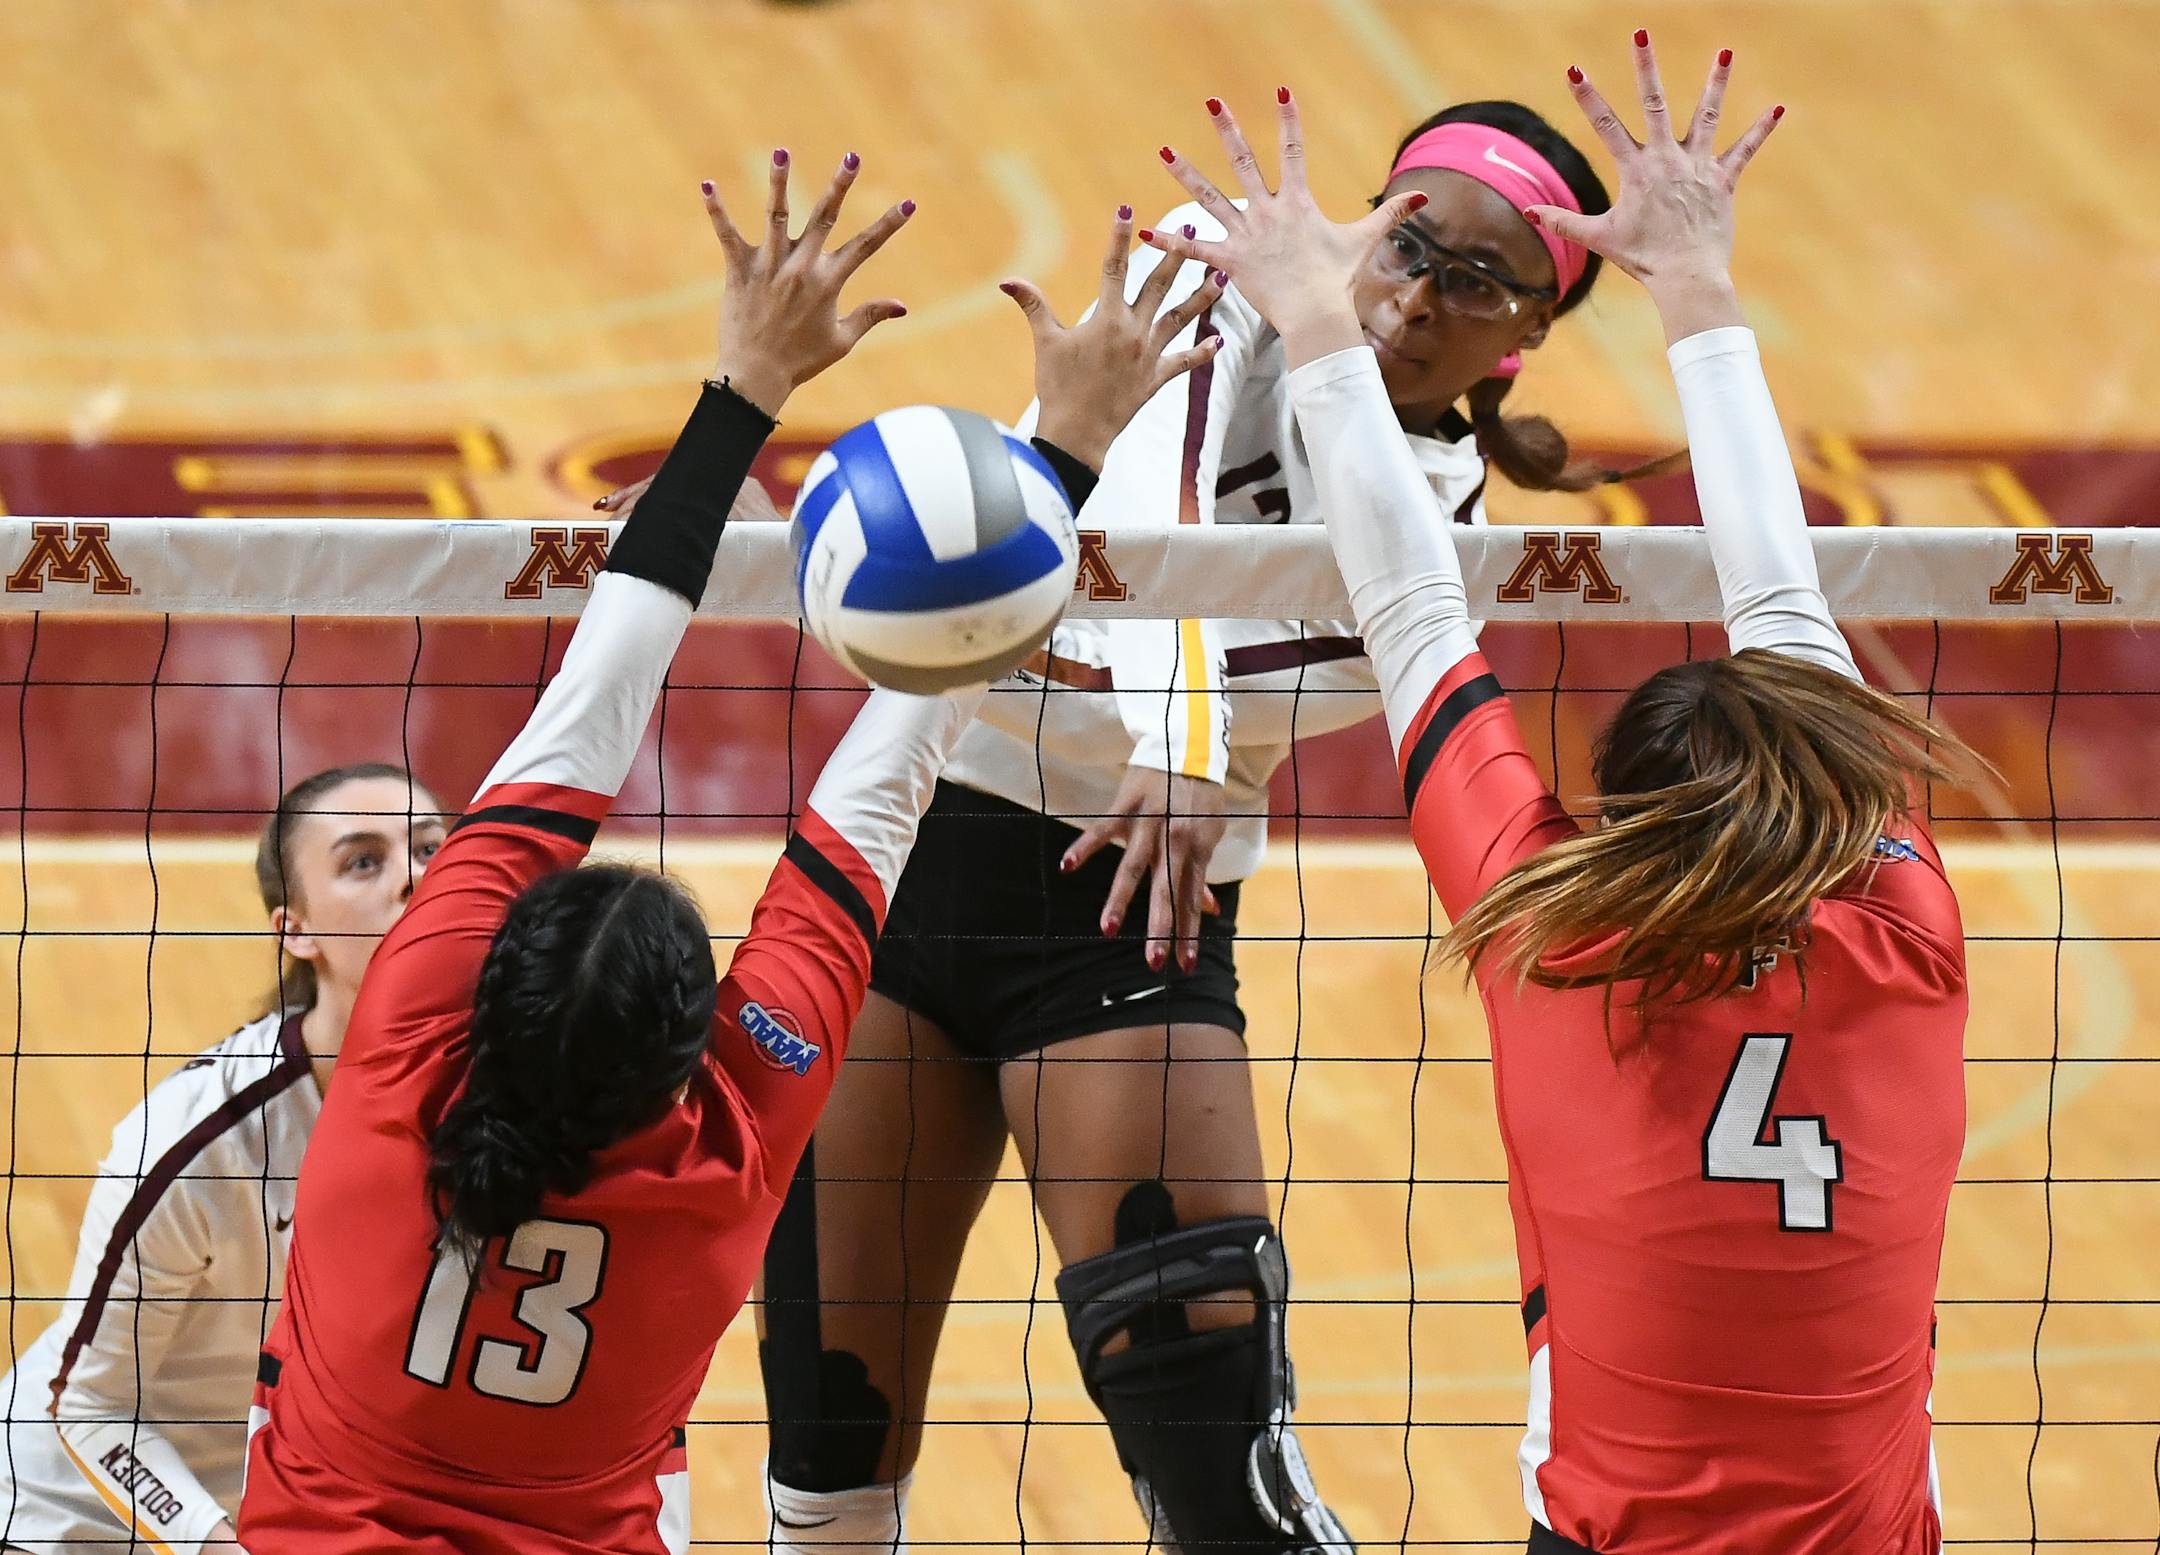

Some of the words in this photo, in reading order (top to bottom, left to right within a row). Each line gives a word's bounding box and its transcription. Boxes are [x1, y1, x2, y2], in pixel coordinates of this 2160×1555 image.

[6, 521, 131, 595] M
[1497, 532, 1621, 603] M
[1990, 533, 2113, 605] M
[737, 1000, 821, 1076] MAAC
[1702, 1033, 1844, 1232] 4
[403, 1217, 609, 1408] 13
[98, 1443, 184, 1526] GOLDEN
